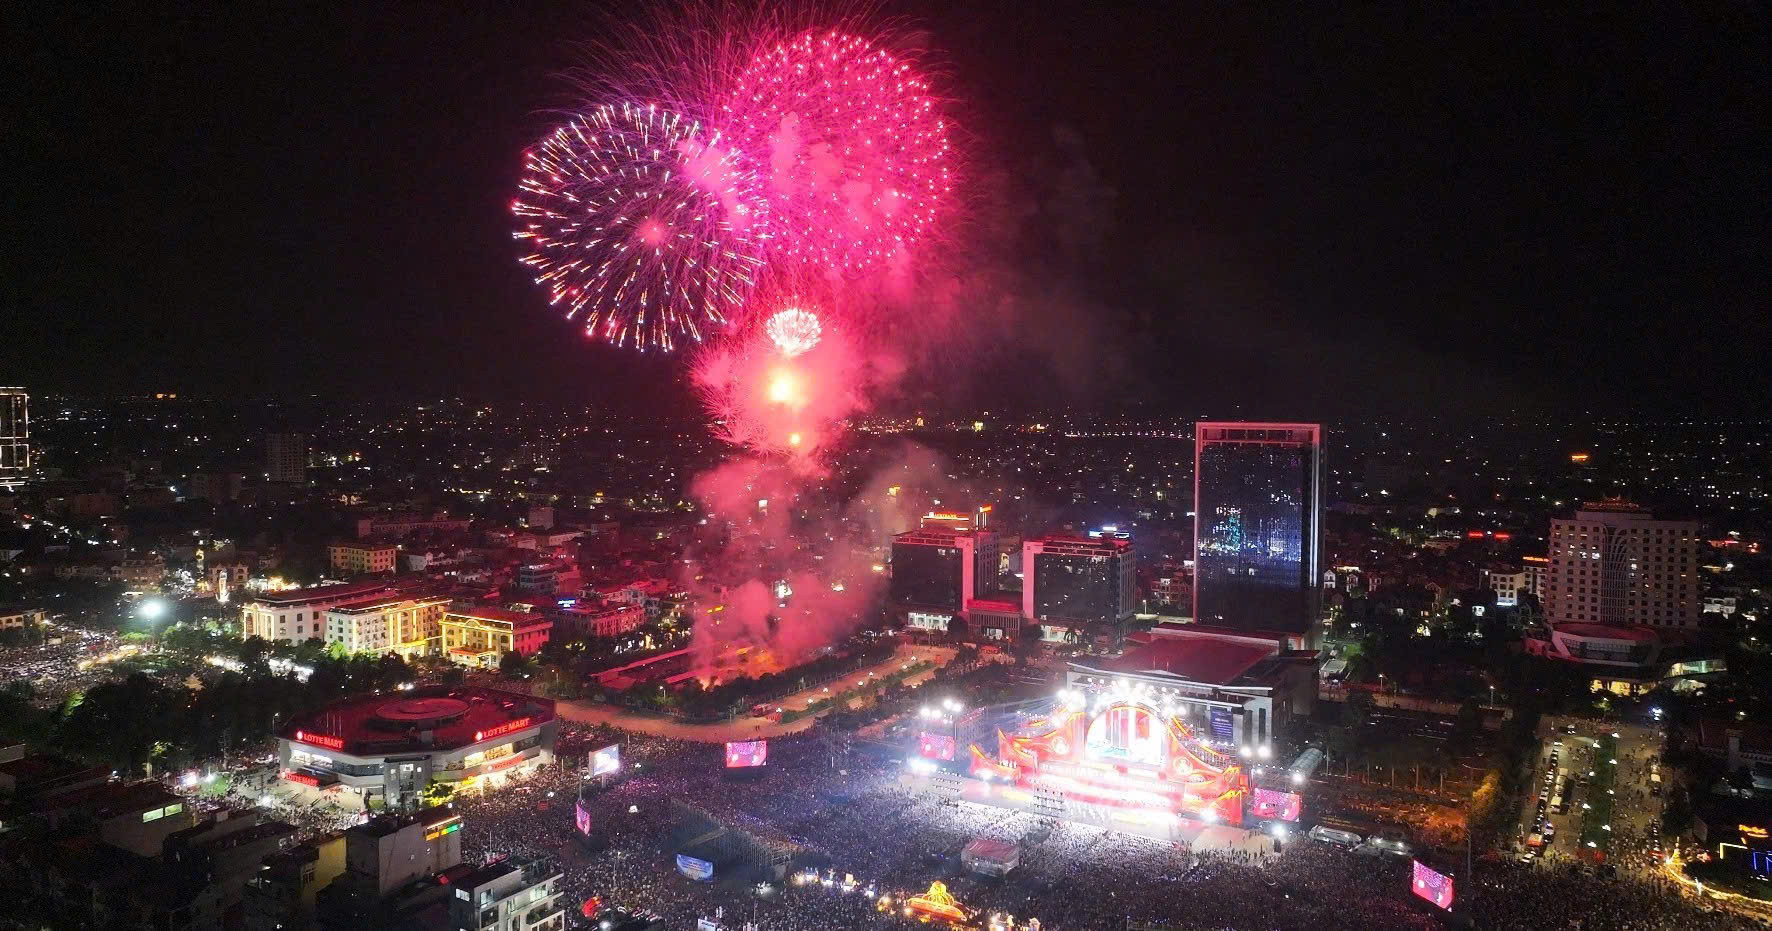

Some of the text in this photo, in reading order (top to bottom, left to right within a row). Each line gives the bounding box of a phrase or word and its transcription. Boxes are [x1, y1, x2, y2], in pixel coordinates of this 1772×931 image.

[483, 717, 530, 738] LOTTE MART
[304, 733, 343, 748] LOTTE MART
